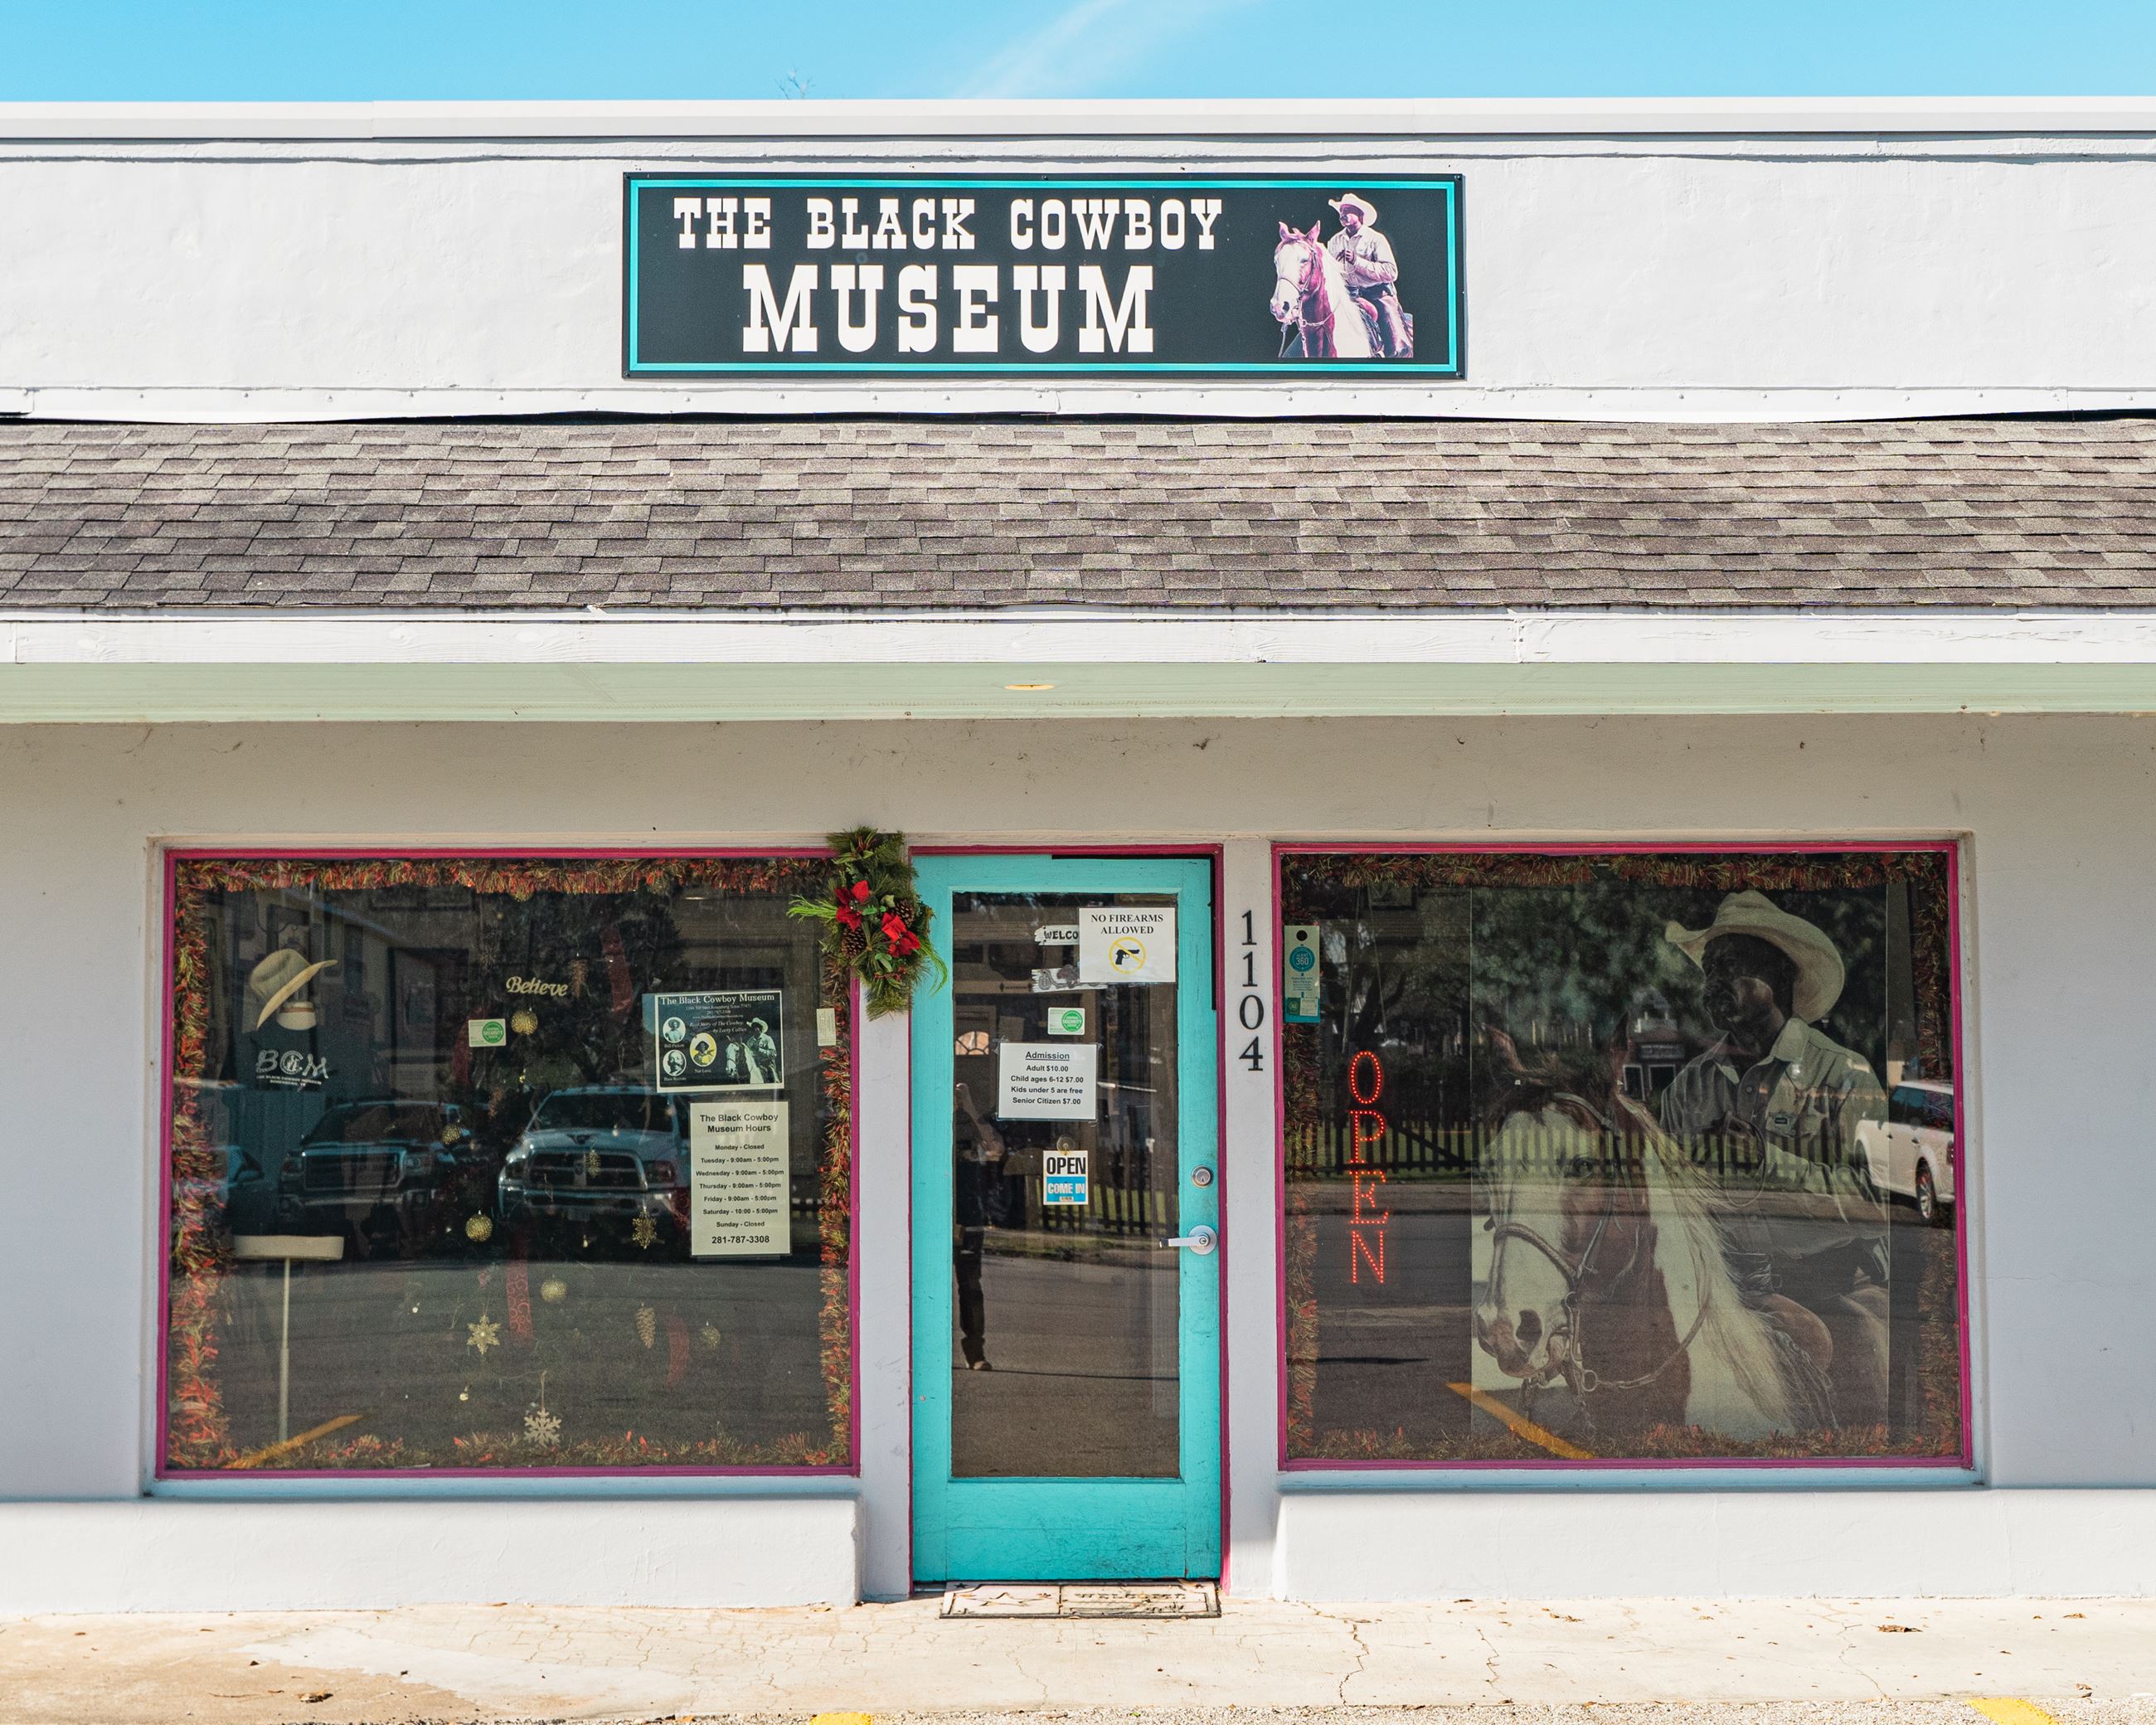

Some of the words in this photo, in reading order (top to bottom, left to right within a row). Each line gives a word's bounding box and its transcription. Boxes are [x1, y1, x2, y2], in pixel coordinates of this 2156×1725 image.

[673, 198, 770, 249] THE
[807, 198, 975, 250] BLACK
[1010, 198, 1222, 250] COWBOY
[742, 265, 1154, 353] MUSEUM
[1109, 914, 1163, 922] FIREARMS
[1101, 926, 1153, 935] ALLOWED
[1296, 957, 1309, 965] 360
[506, 976, 569, 996] Believe
[1239, 910, 1264, 1071] 1104
[660, 997, 677, 1005] The
[679, 996, 701, 1004] Black
[703, 995, 736, 1004] Cowboy
[1026, 1052, 1070, 1060] Admission
[744, 1114, 778, 1122] Cowboy
[1046, 1157, 1086, 1174] OPEN
[1348, 1051, 1389, 1284] OPEN
[1048, 1183, 1073, 1193] COME
[1076, 1183, 1085, 1193] IN
[711, 1236, 770, 1244] 281-787-3308
